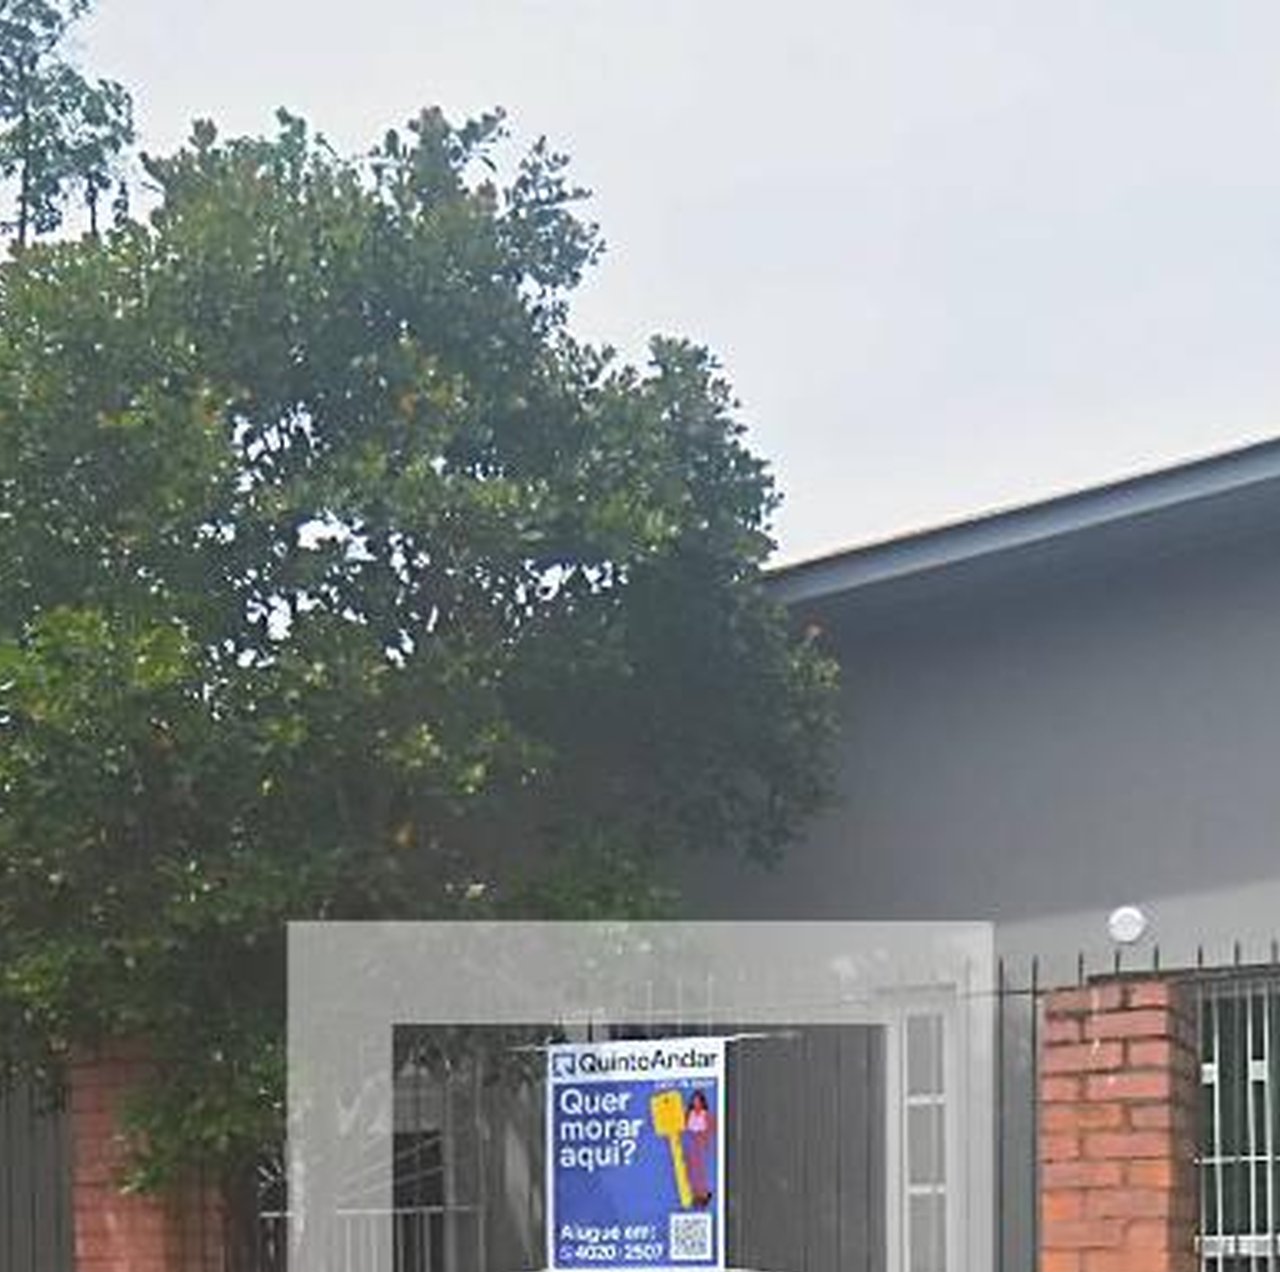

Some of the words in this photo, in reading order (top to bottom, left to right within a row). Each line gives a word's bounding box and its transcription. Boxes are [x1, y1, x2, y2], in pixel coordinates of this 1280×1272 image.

[578, 1049, 718, 1073] QuintoAndar
[560, 1088, 632, 1115] Quer
[560, 1118, 644, 1140] morar
[560, 1139, 637, 1173] aqui?
